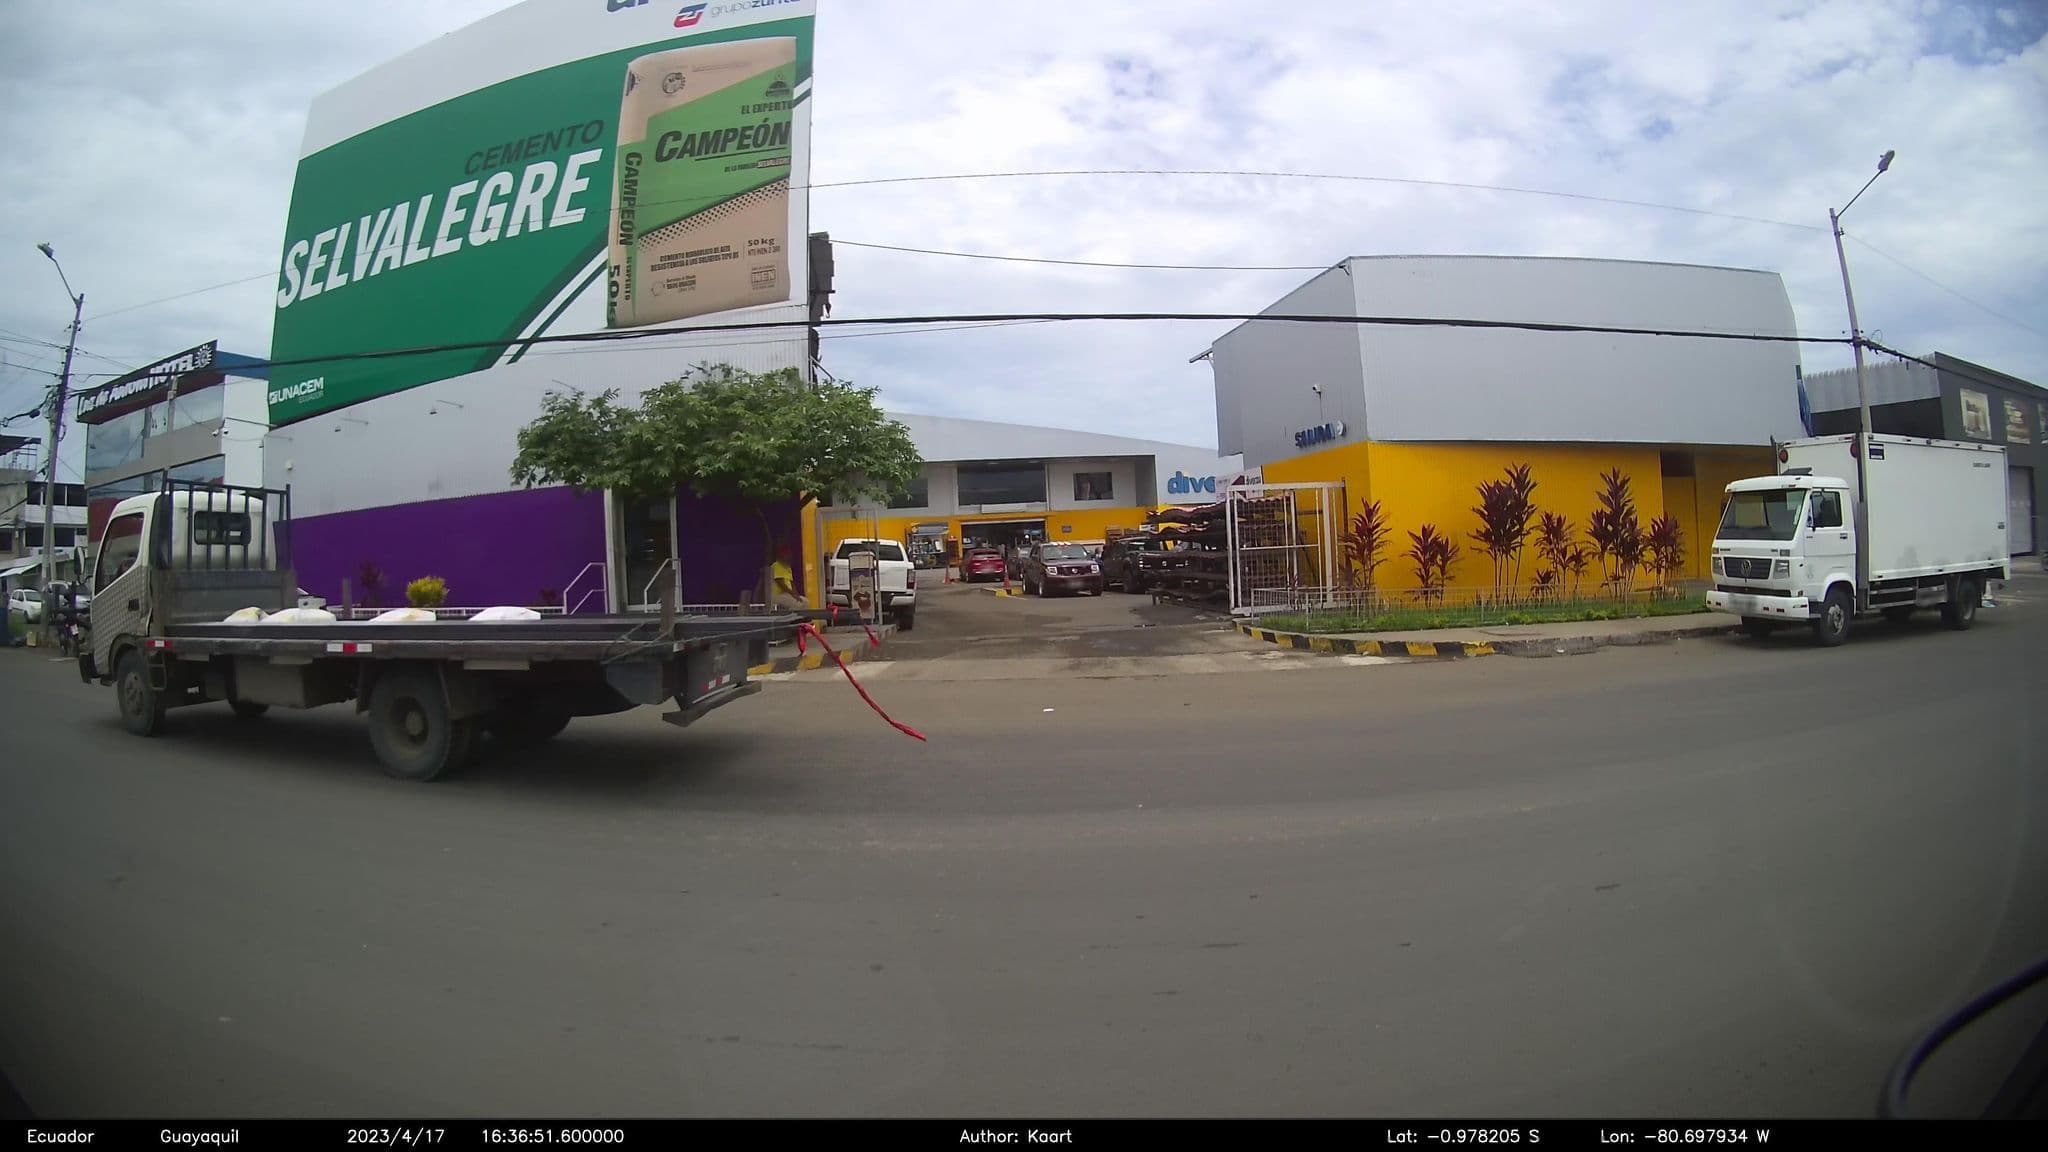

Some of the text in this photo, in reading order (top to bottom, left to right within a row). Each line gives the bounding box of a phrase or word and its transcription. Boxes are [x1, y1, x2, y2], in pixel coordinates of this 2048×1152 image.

[464, 119, 604, 176] CEMENTO
[655, 117, 792, 163] CAMPEÓN
[277, 148, 603, 308] SELVALEGRE
[747, 239, 760, 247] 50
[278, 377, 324, 402] UNACEM
